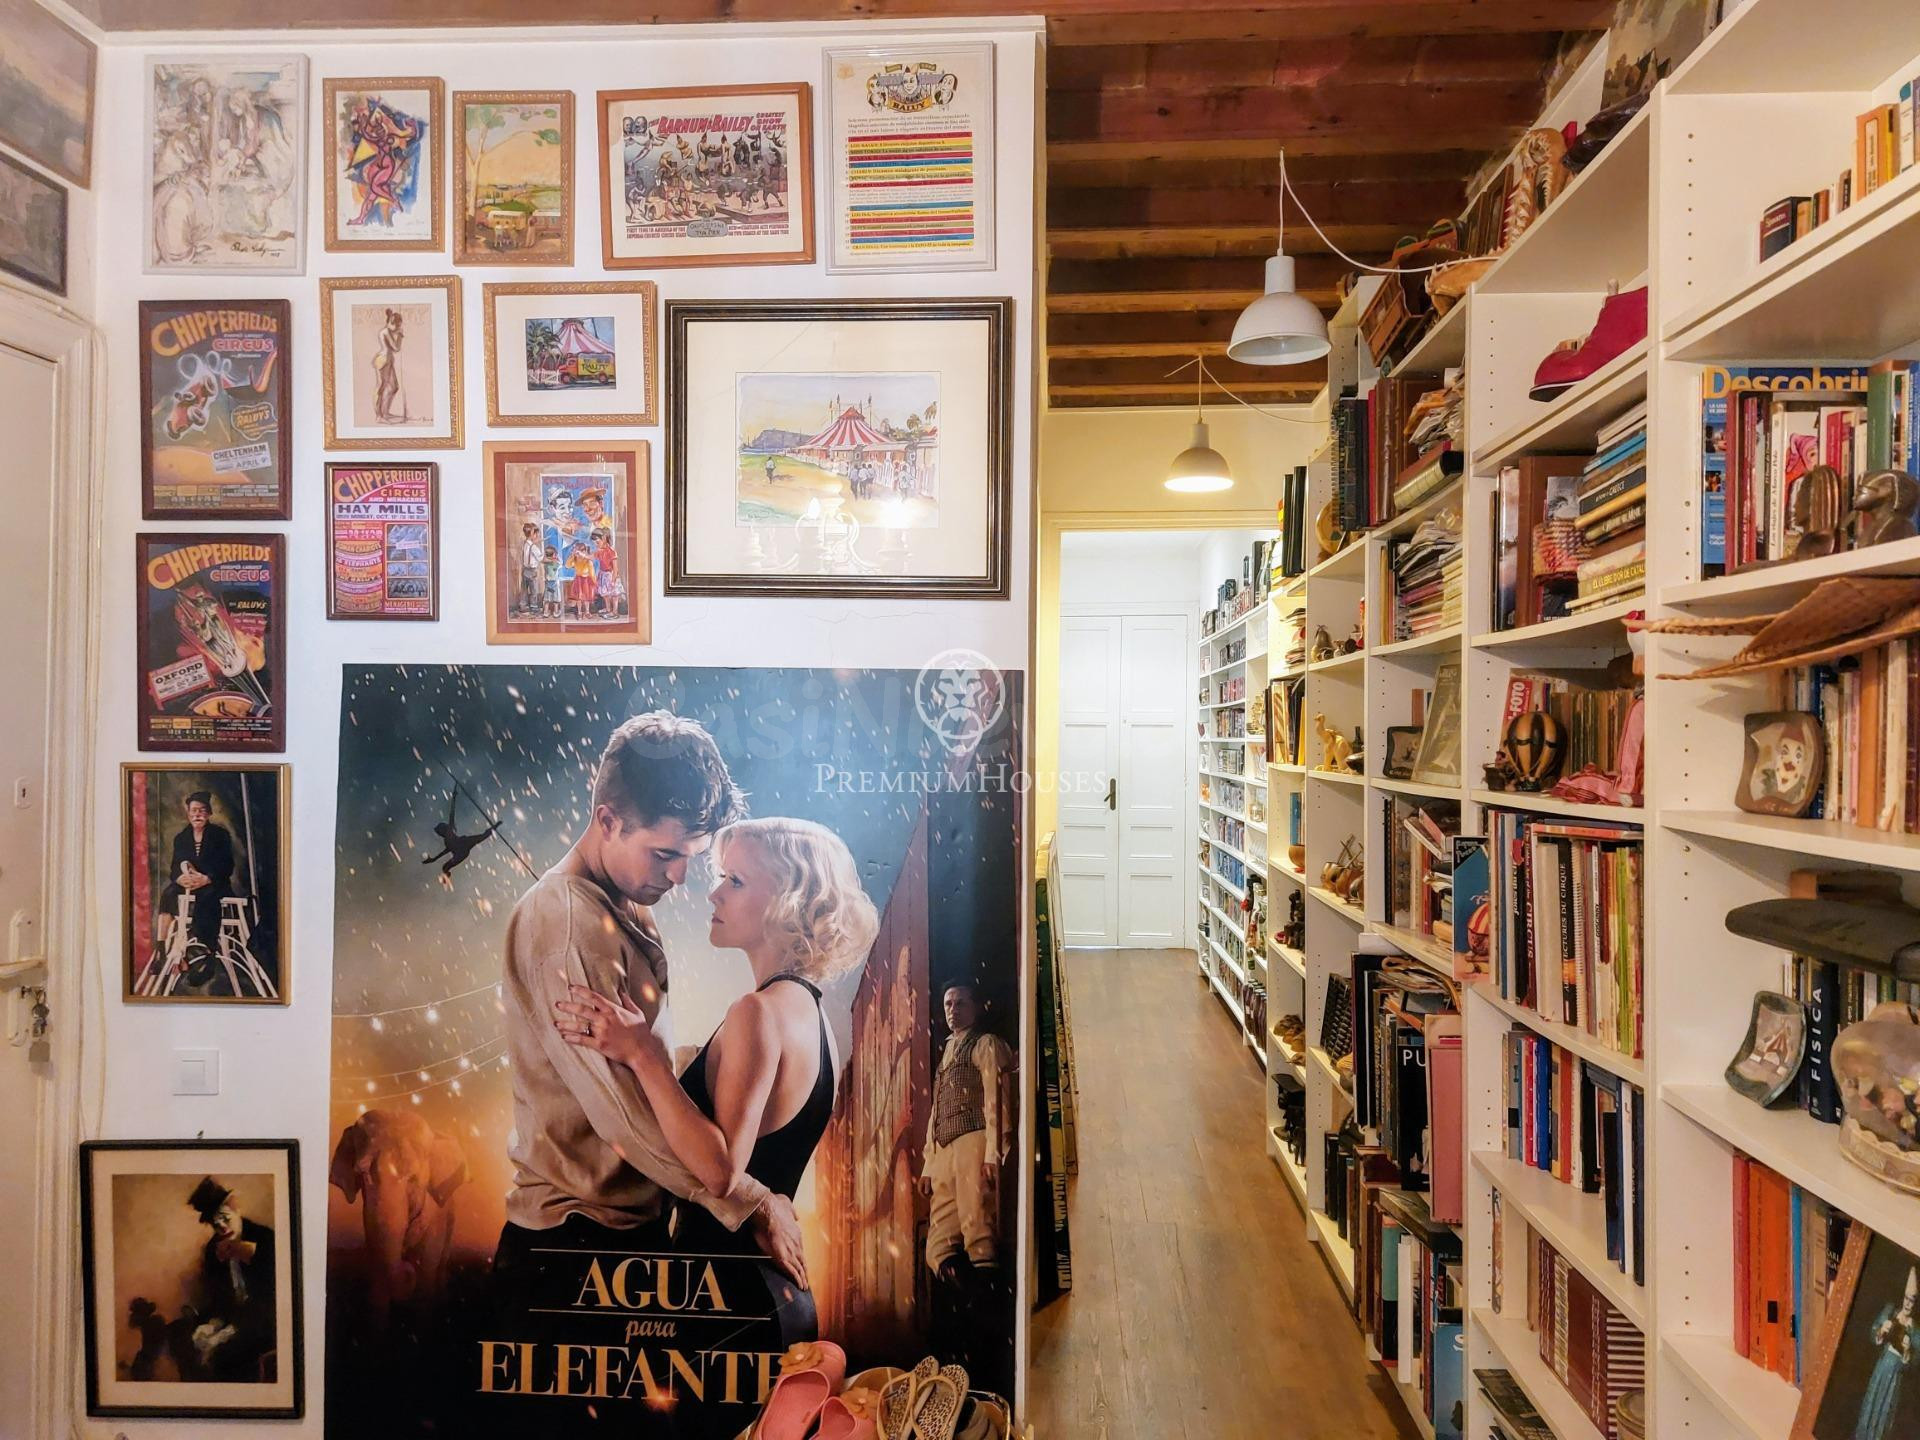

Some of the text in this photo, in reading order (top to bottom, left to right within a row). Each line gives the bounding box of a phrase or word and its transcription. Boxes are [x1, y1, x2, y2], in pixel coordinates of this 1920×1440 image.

[657, 116, 709, 133] BARNUM
[711, 114, 755, 132] BAILEY
[151, 309, 278, 357] CHIPPERFIELDS
[211, 338, 274, 352] CIRCUS
[212, 444, 267, 461] CHELTENHAM
[236, 460, 260, 468] APRIL
[334, 470, 428, 503] CHIPPERFIELDS
[380, 488, 427, 497] CIRCUS
[338, 504, 426, 515] HAY MILLS
[147, 543, 271, 590] CHIPPERFIELDS
[209, 569, 271, 582] CIRCUS
[155, 662, 204, 685] OXFORD
[1561, 901, 1568, 914] DU
[1525, 901, 1535, 959] CIRCUS
[1811, 988, 1823, 1082] FISICA
[571, 1256, 732, 1312] AGUA
[624, 1319, 678, 1344] para
